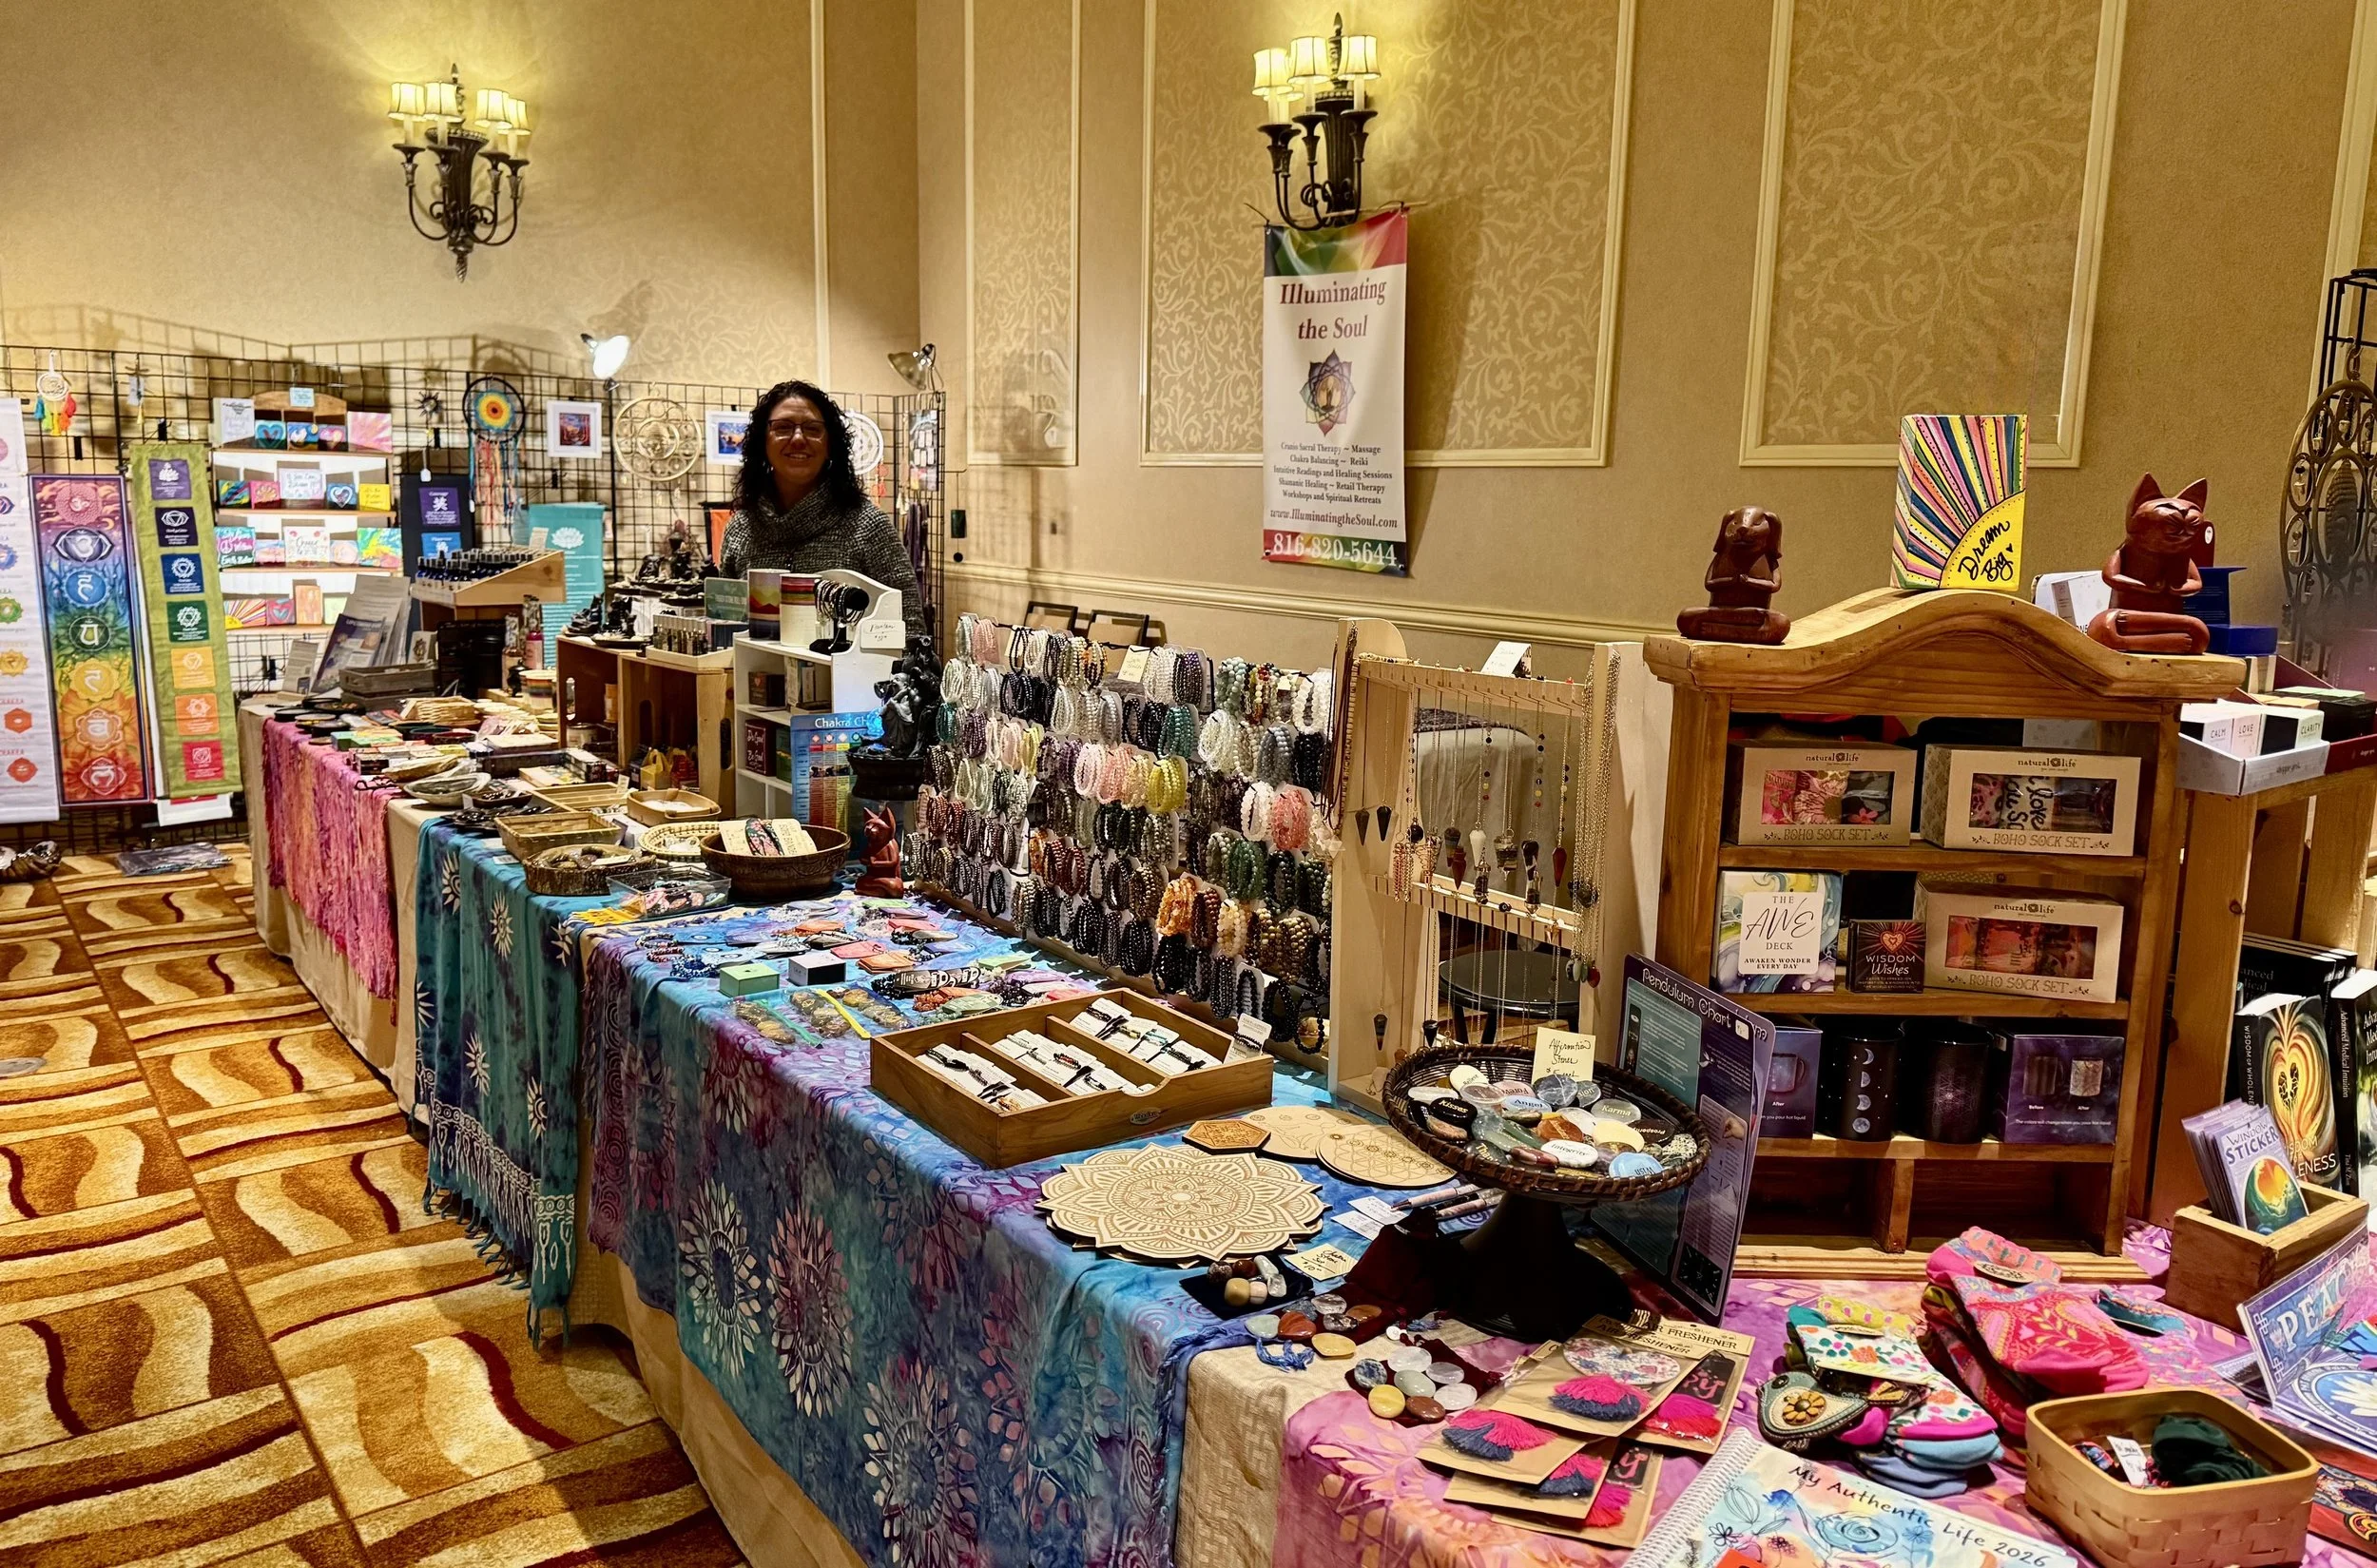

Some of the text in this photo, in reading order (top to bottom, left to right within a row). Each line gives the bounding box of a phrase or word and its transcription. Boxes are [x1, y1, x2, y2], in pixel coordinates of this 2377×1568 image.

[1280, 278, 1387, 305] Illuminating
[1298, 315, 1368, 339] the Soul
[1317, 444, 1342, 455] Therapy
[1351, 444, 1382, 455] Massage
[1290, 455, 1309, 463] Chakra
[1310, 456, 1339, 467] Balancing
[1350, 457, 1368, 466] Reiki
[1274, 465, 1295, 474] Intuitive
[1297, 467, 1322, 478] Readings
[1336, 470, 1362, 480] Healing
[1362, 471, 1392, 479] Sessions
[1279, 477, 1303, 487] Shamanic
[1304, 480, 1328, 490] Healing
[1336, 482, 1355, 491] Retail
[1358, 483, 1385, 494] Therapy
[1283, 490, 1382, 504] Workshops and Spiritual Retreats
[1270, 509, 1398, 529] www.IlluminatingtheSoul.com
[1274, 532, 1397, 567] 816-820-5644
[1958, 520, 2011, 581] Dream
[1981, 552, 2014, 582] Big
[814, 717, 851, 728] Chakra
[2238, 724, 2254, 734] LOVE
[2300, 723, 2321, 735] CLARITY
[2210, 727, 2227, 739] CALM
[1806, 752, 1860, 762] natural life
[2018, 758, 2076, 767] natural life
[1784, 828, 1871, 841] BOHO SOCK SET
[1993, 833, 2091, 848] BOHO SOCK SET
[1772, 896, 1794, 904] THE
[1994, 903, 2055, 914] natural life
[1746, 897, 1816, 941] AWE
[1865, 955, 1916, 963] WISDOM
[1871, 962, 1909, 977] Wishes
[2240, 968, 2274, 981] anced
[1969, 974, 2069, 994] BOHO SOCK SET
[1642, 968, 1732, 1029] Pendulum Chart
[1549, 1038, 1591, 1055] Affirmation
[2244, 1025, 2252, 1058] WISDOM
[2340, 1010, 2350, 1098] Advanced Medical Intuition
[2246, 1067, 2254, 1106] WHOLENE
[1438, 1099, 1469, 1113] Kisses
[1601, 1104, 1632, 1117] Karma
[2226, 1123, 2269, 1146] WINDOW
[1475, 1142, 1498, 1162] Than
[2225, 1126, 2279, 1165] STICKER
[2287, 1136, 2318, 1156] ISDOM
[2295, 1153, 2336, 1179] ENESS
[1668, 1327, 1738, 1350] FRESHENER
[1788, 1465, 2053, 1568] My Authentic Life 2026
